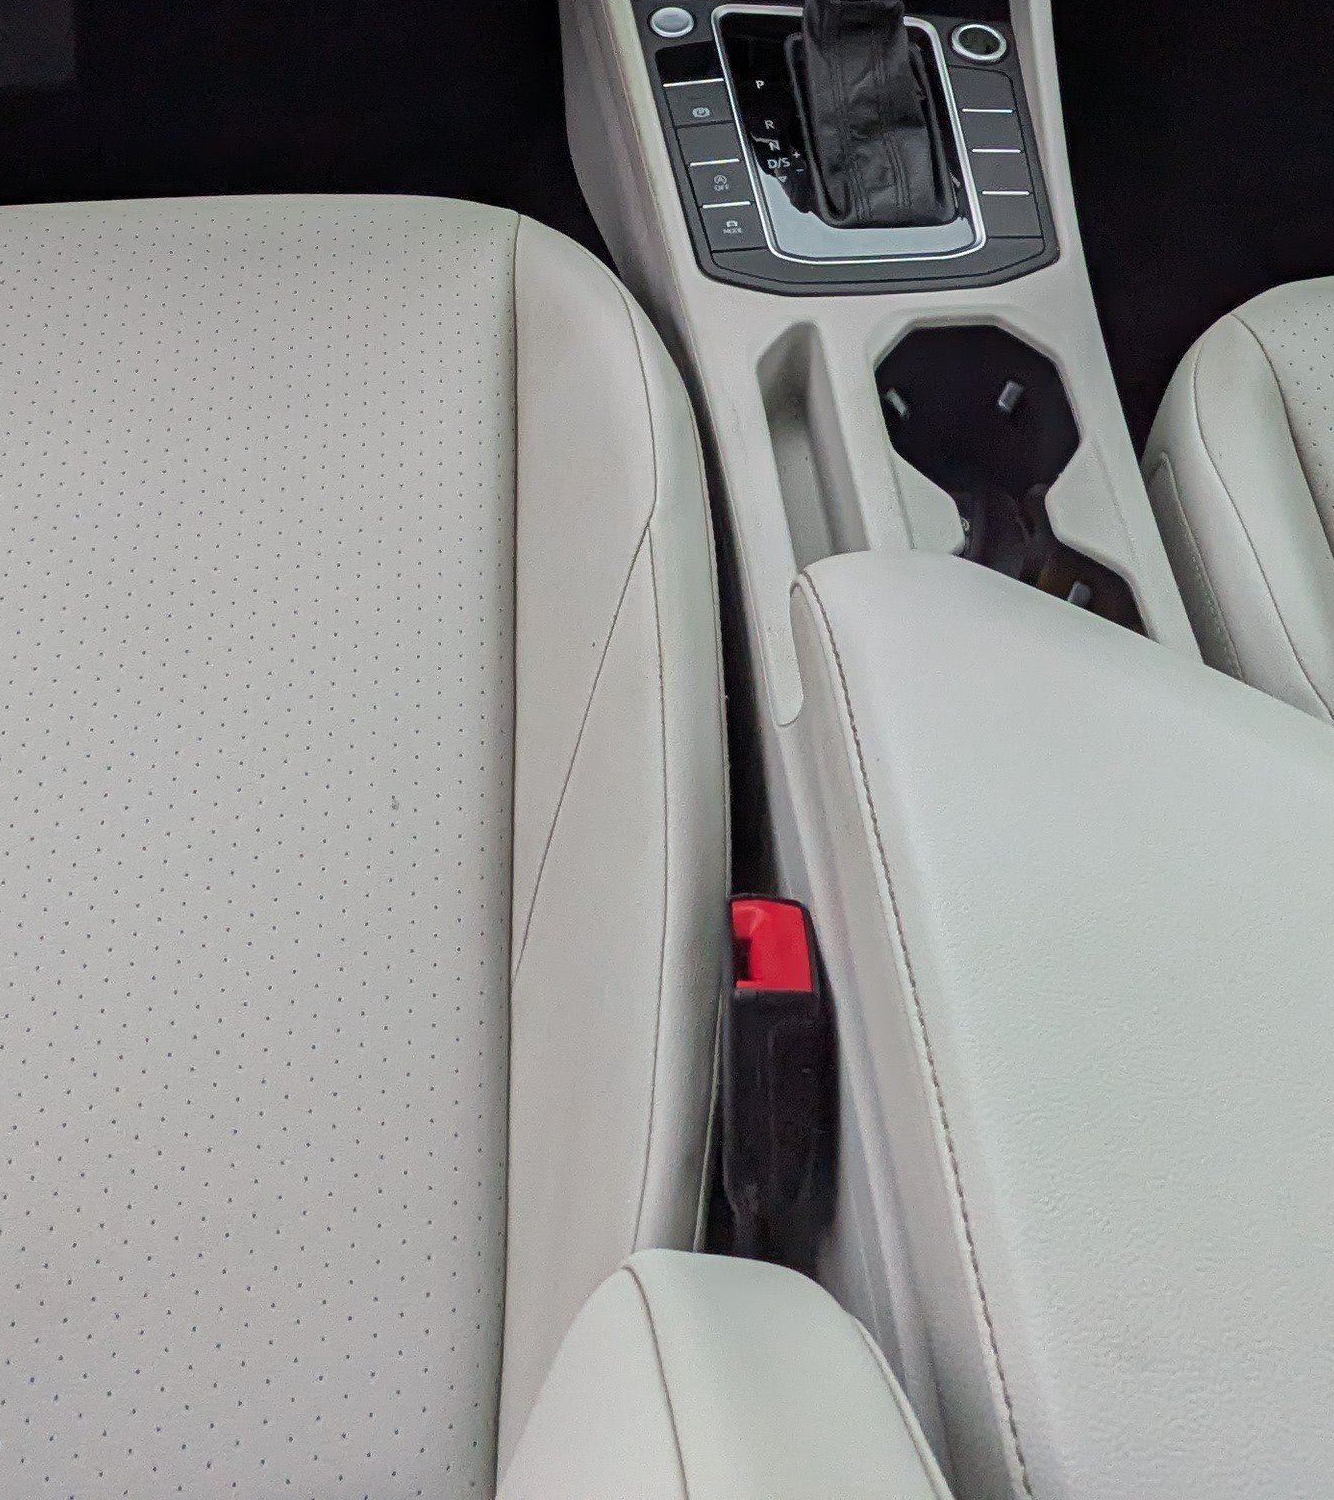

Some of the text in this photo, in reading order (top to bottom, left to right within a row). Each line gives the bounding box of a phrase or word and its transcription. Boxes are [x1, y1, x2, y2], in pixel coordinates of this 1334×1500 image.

[755, 80, 765, 89] P
[764, 120, 775, 129] R
[769, 141, 780, 150] N
[767, 158, 791, 169] D/S
